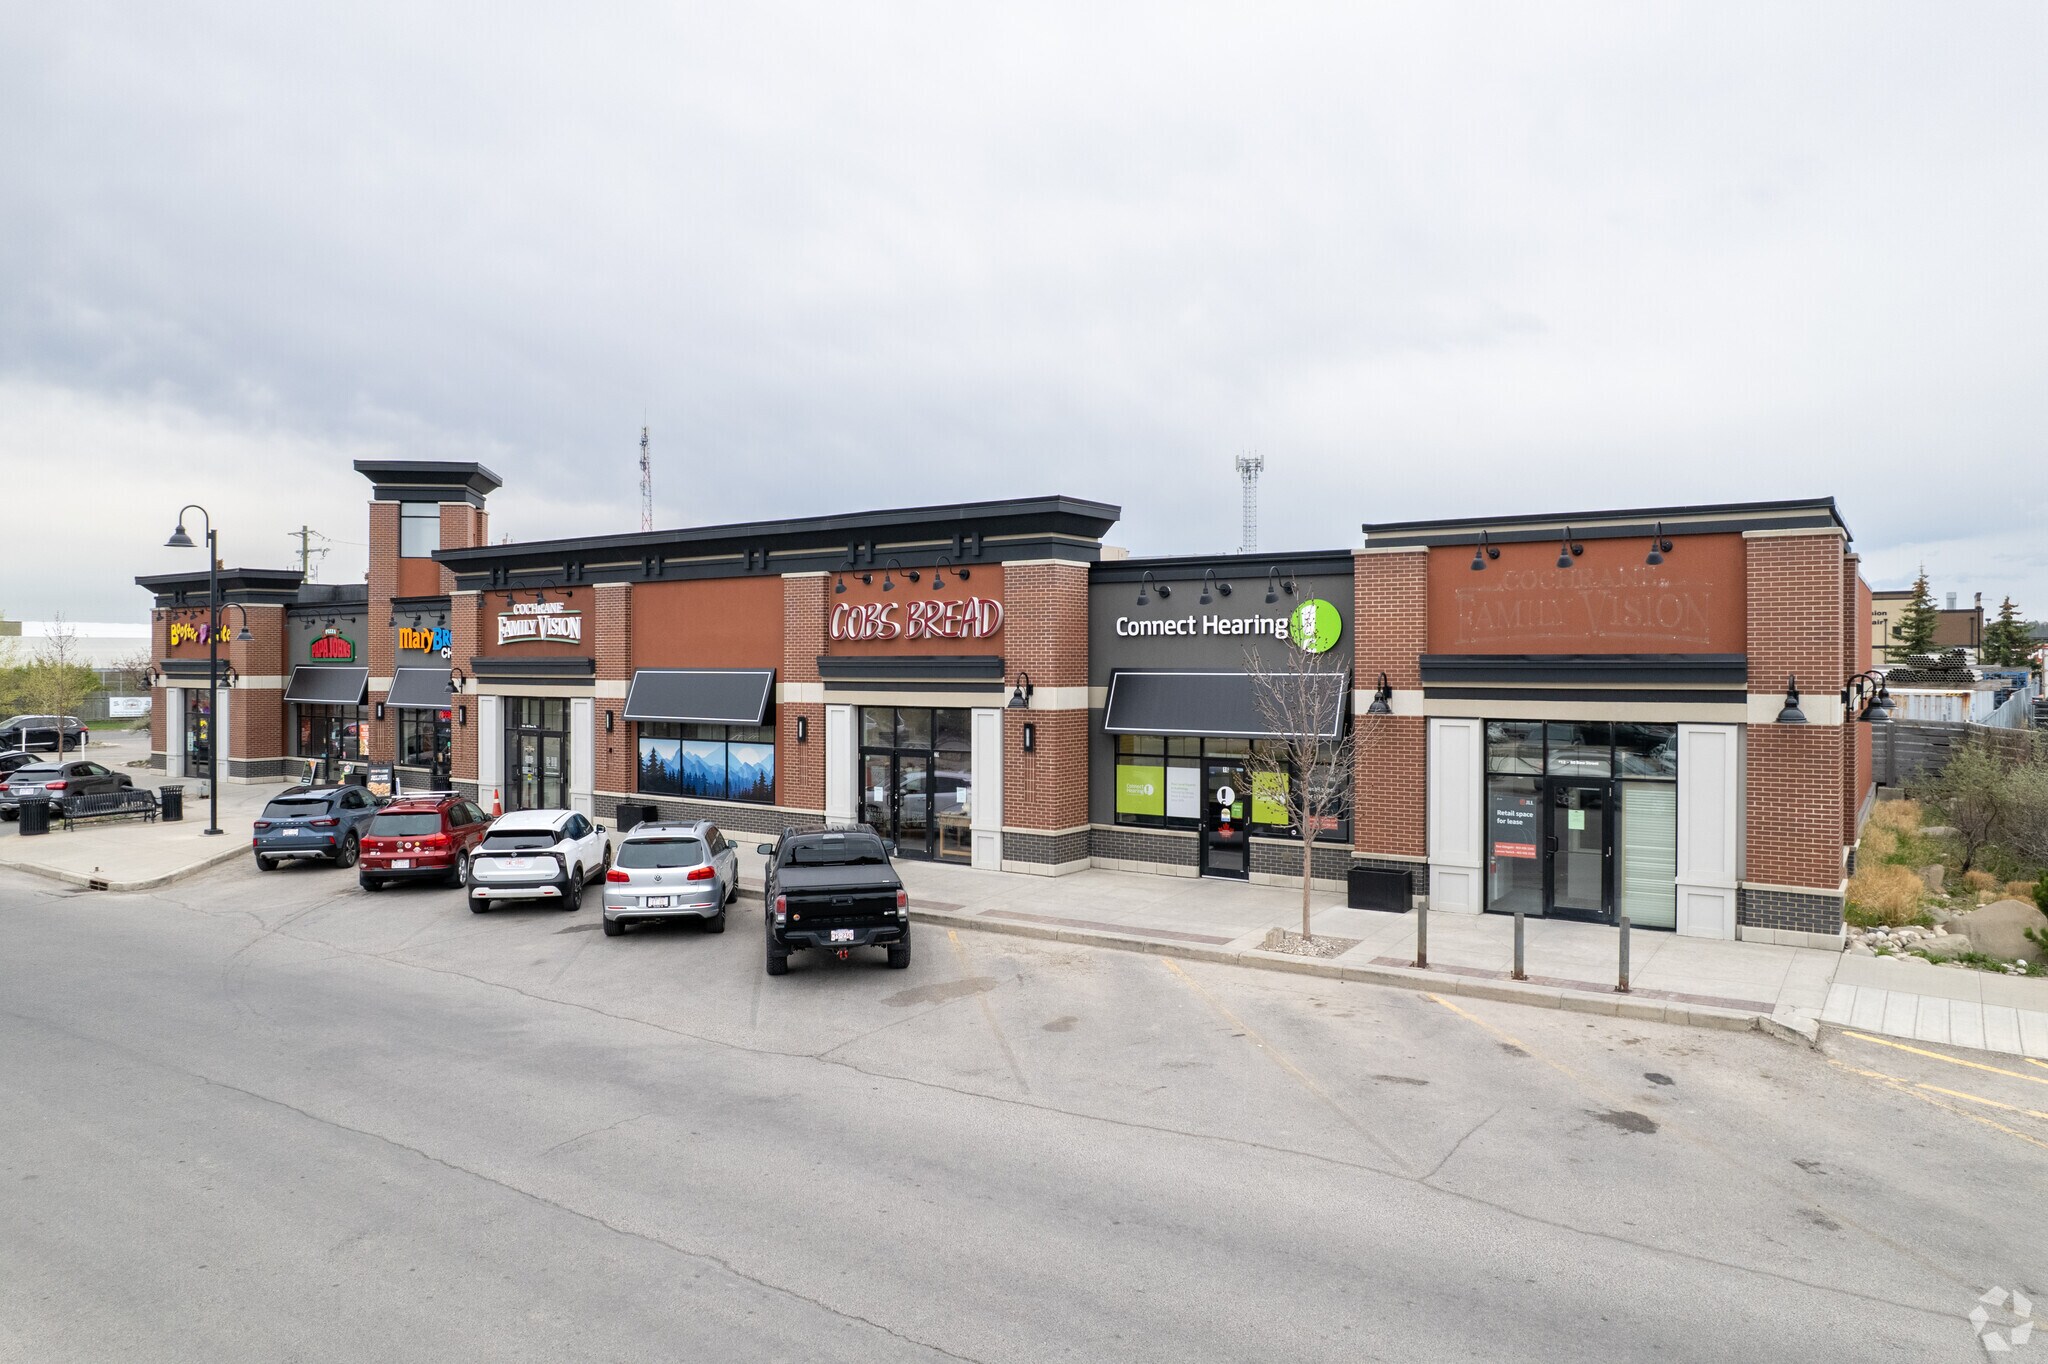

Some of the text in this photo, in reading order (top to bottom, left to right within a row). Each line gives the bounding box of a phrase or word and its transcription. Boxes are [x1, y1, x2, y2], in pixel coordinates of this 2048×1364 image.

[513, 602, 565, 615] COCHRANE
[829, 596, 1005, 641] COBS BREAD
[497, 615, 582, 645] FAMILY VISION
[1116, 614, 1289, 640] Connect Hearing
[1496, 809, 1515, 817] Retail
